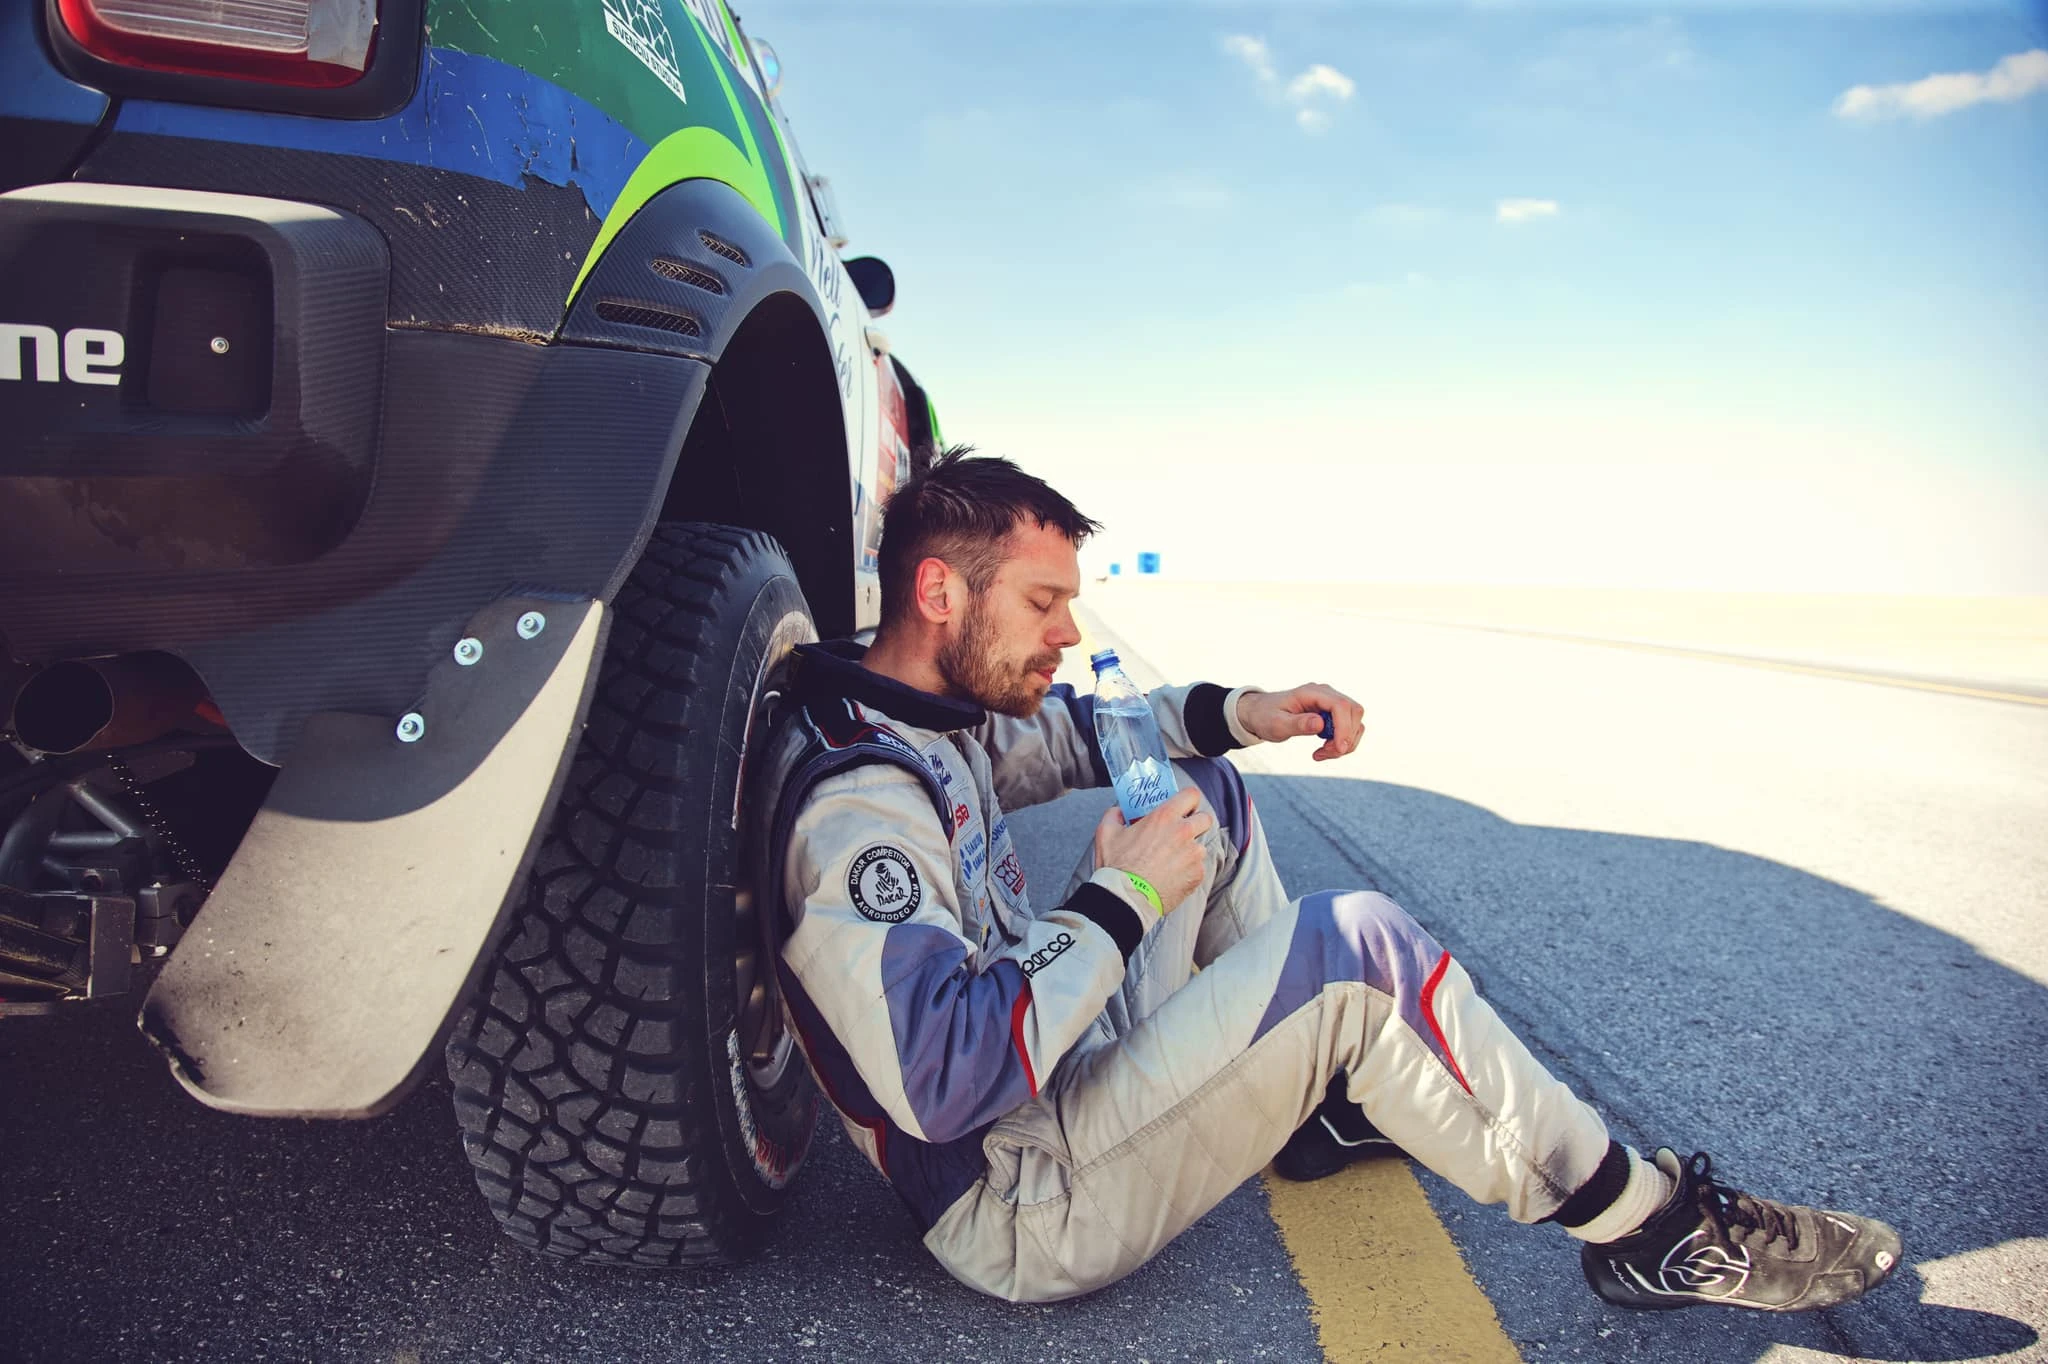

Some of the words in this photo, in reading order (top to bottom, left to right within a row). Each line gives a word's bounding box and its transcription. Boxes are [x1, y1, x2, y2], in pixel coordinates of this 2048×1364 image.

[1129, 787, 1169, 808] Water
[850, 859, 867, 885] DAKAR
[866, 848, 911, 869] COMPETITOR
[857, 901, 910, 921] AGRORODEO
[909, 883, 921, 907] TEAM
[875, 886, 908, 907] DAKAR
[1022, 932, 1073, 979] parco
